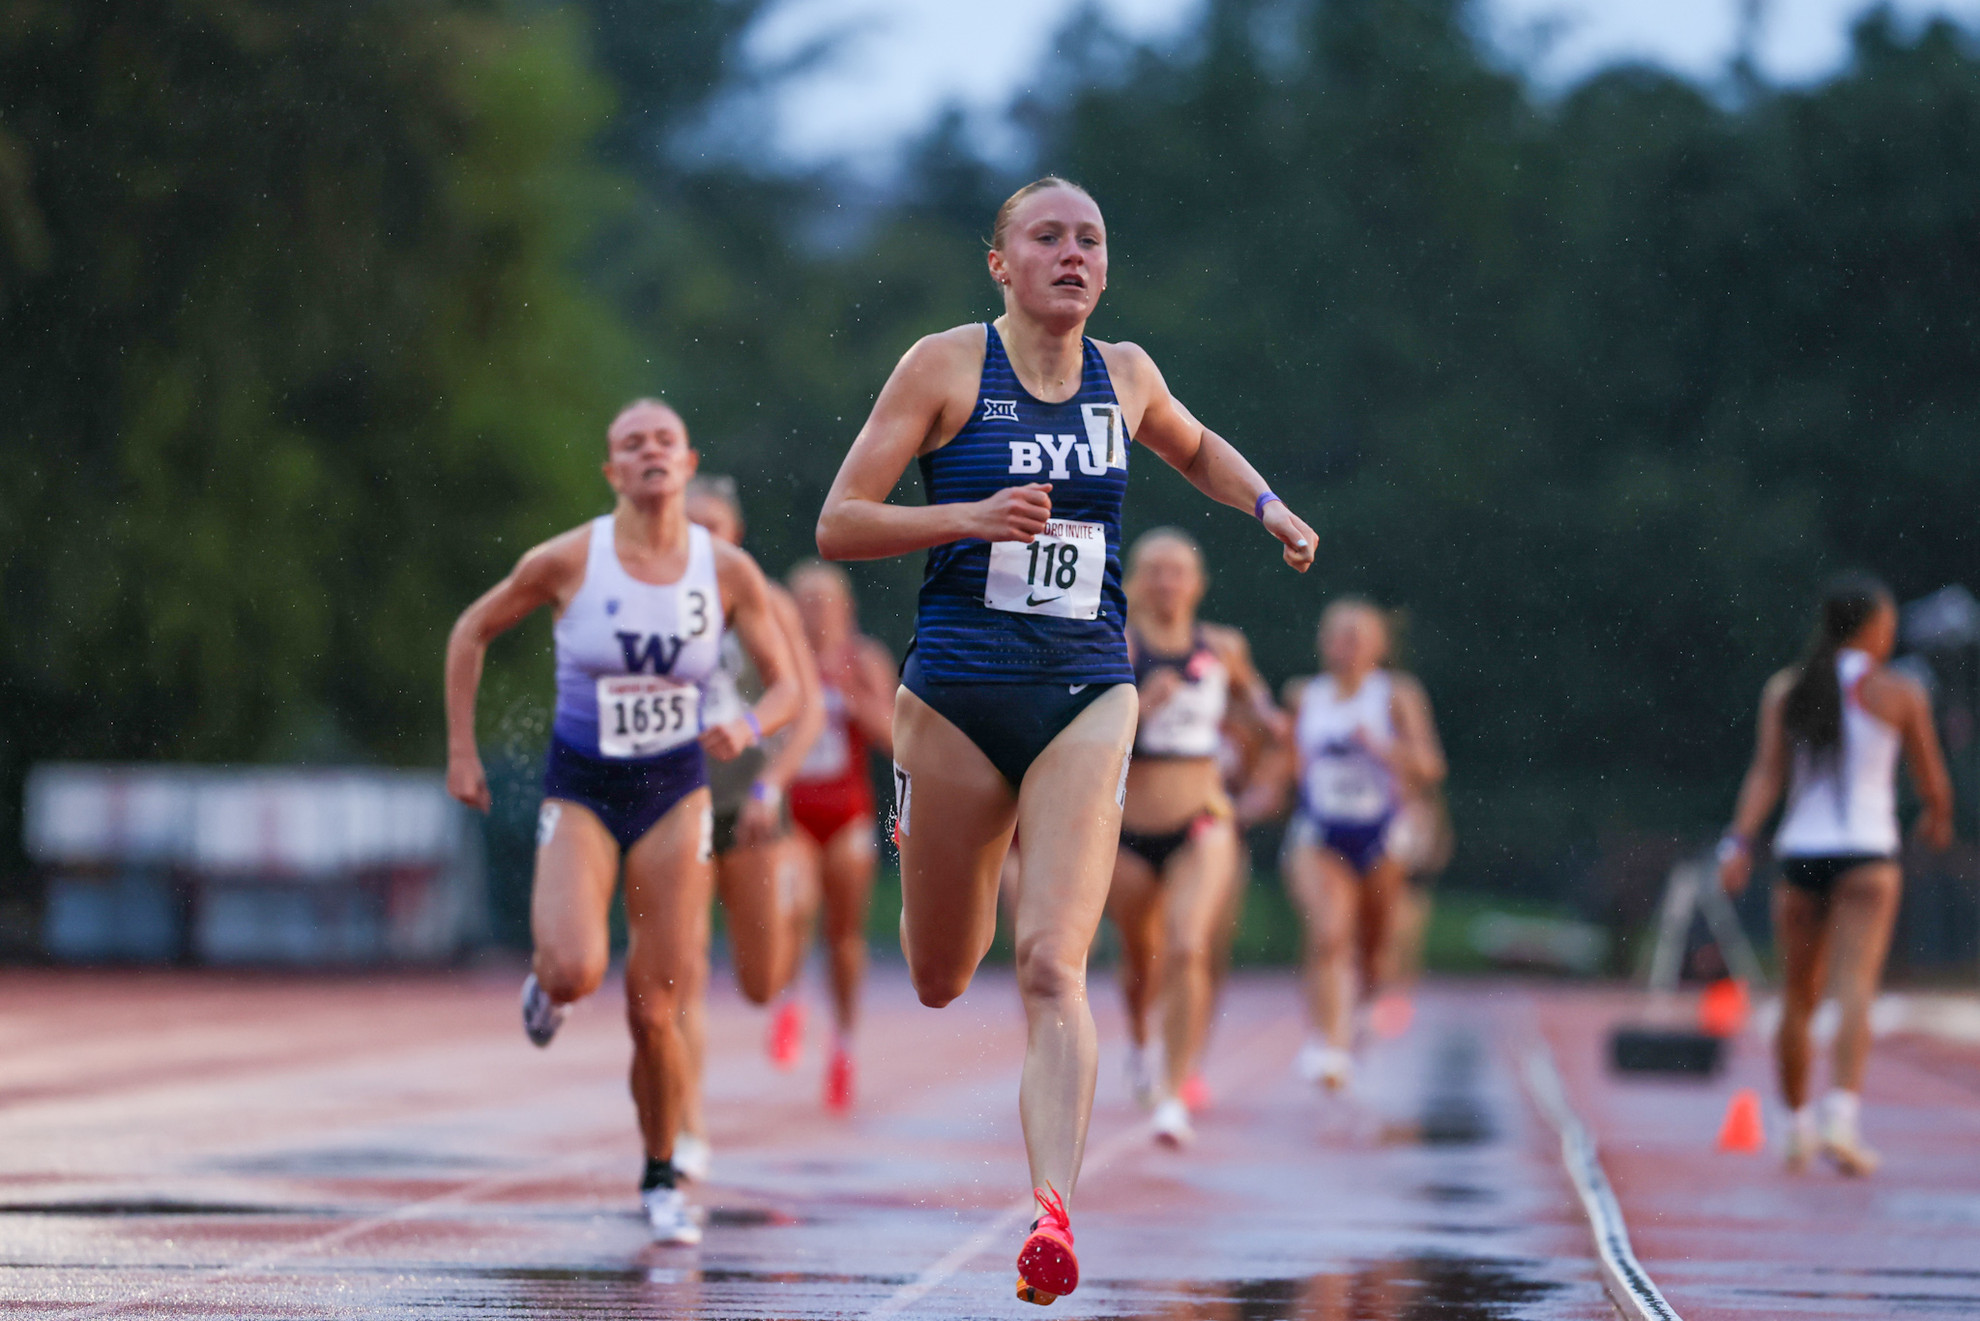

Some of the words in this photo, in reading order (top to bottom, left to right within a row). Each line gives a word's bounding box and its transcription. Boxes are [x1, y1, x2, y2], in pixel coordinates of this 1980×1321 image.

[1008, 433, 1108, 480] BYU
[1091, 407, 1114, 463] 7
[1065, 523, 1094, 540] INVITE
[1026, 540, 1079, 590] 118
[688, 591, 708, 636] 3
[614, 631, 686, 674] W
[615, 695, 684, 736] 1655
[895, 767, 907, 823] 7
